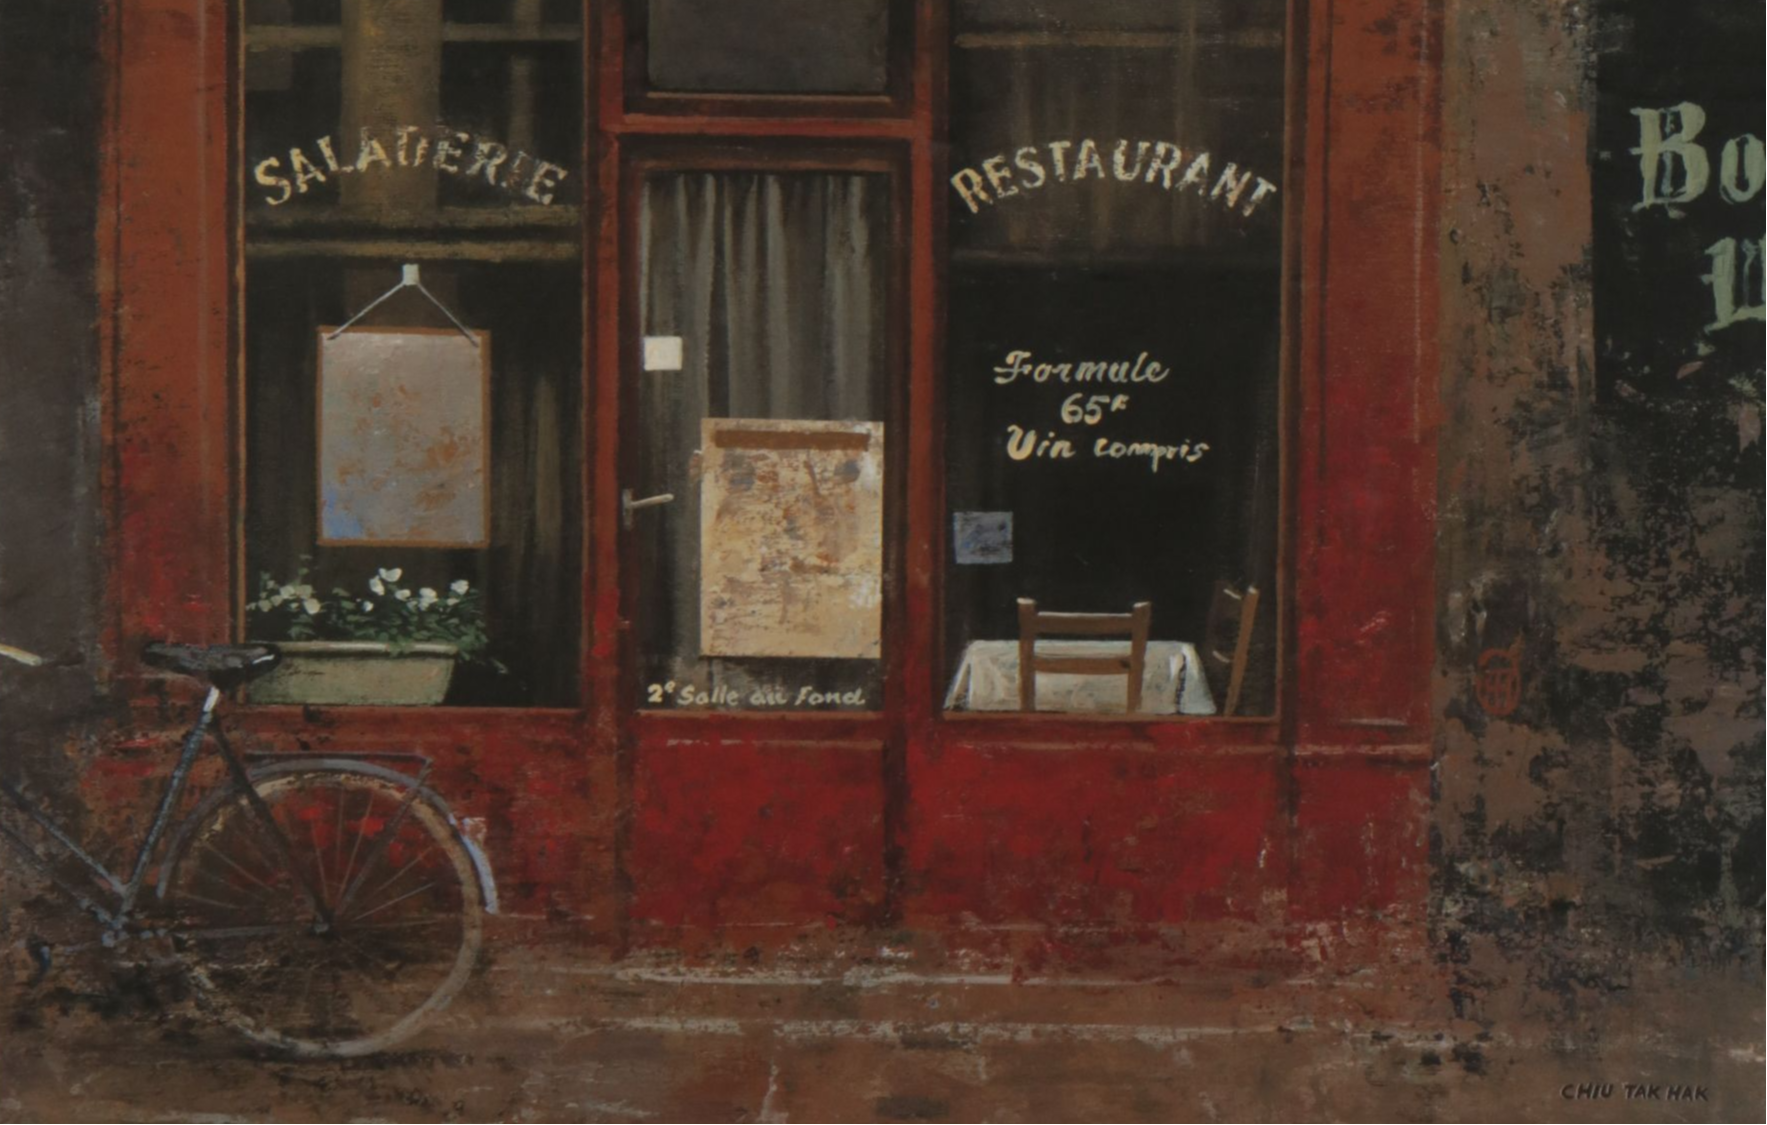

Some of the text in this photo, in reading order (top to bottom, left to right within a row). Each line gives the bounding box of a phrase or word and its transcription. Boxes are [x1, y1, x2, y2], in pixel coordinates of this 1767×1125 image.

[950, 138, 1277, 217] RESTAURANT
[993, 350, 1170, 384] Formule
[1093, 437, 1210, 474] compris
[676, 684, 740, 706] Salle
[1560, 1083, 1709, 1102] CHIU TAK HAK
